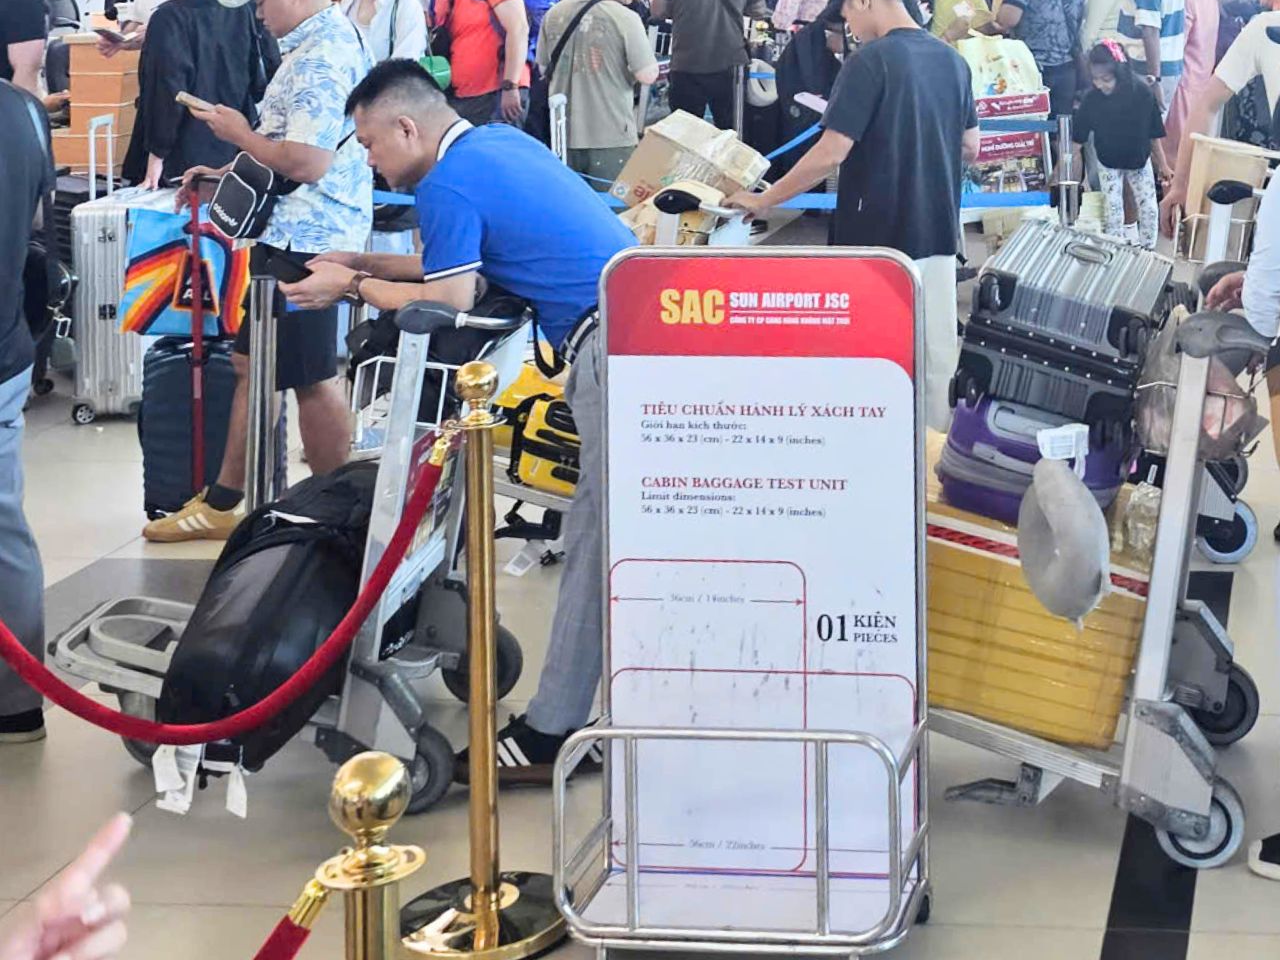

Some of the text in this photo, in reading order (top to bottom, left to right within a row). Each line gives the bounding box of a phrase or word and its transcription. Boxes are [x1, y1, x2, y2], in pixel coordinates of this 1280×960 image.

[660, 288, 725, 325] SAC
[729, 292, 850, 309] SUN AIRPORT JSC
[641, 401, 677, 416] TIÊU
[788, 403, 807, 417] LÝ
[811, 403, 855, 418] XÁCH
[858, 406, 886, 418] TAY
[732, 435, 744, 443] 22
[755, 435, 766, 444] 14
[778, 435, 784, 444] 9
[641, 477, 848, 490] CABIN BAGGAGE TEST UNIT
[641, 491, 670, 500] Limit
[732, 506, 744, 515] 22
[756, 506, 766, 515] 14
[778, 506, 784, 515] 9
[816, 613, 849, 642] 01
[854, 632, 898, 643] PIECES
